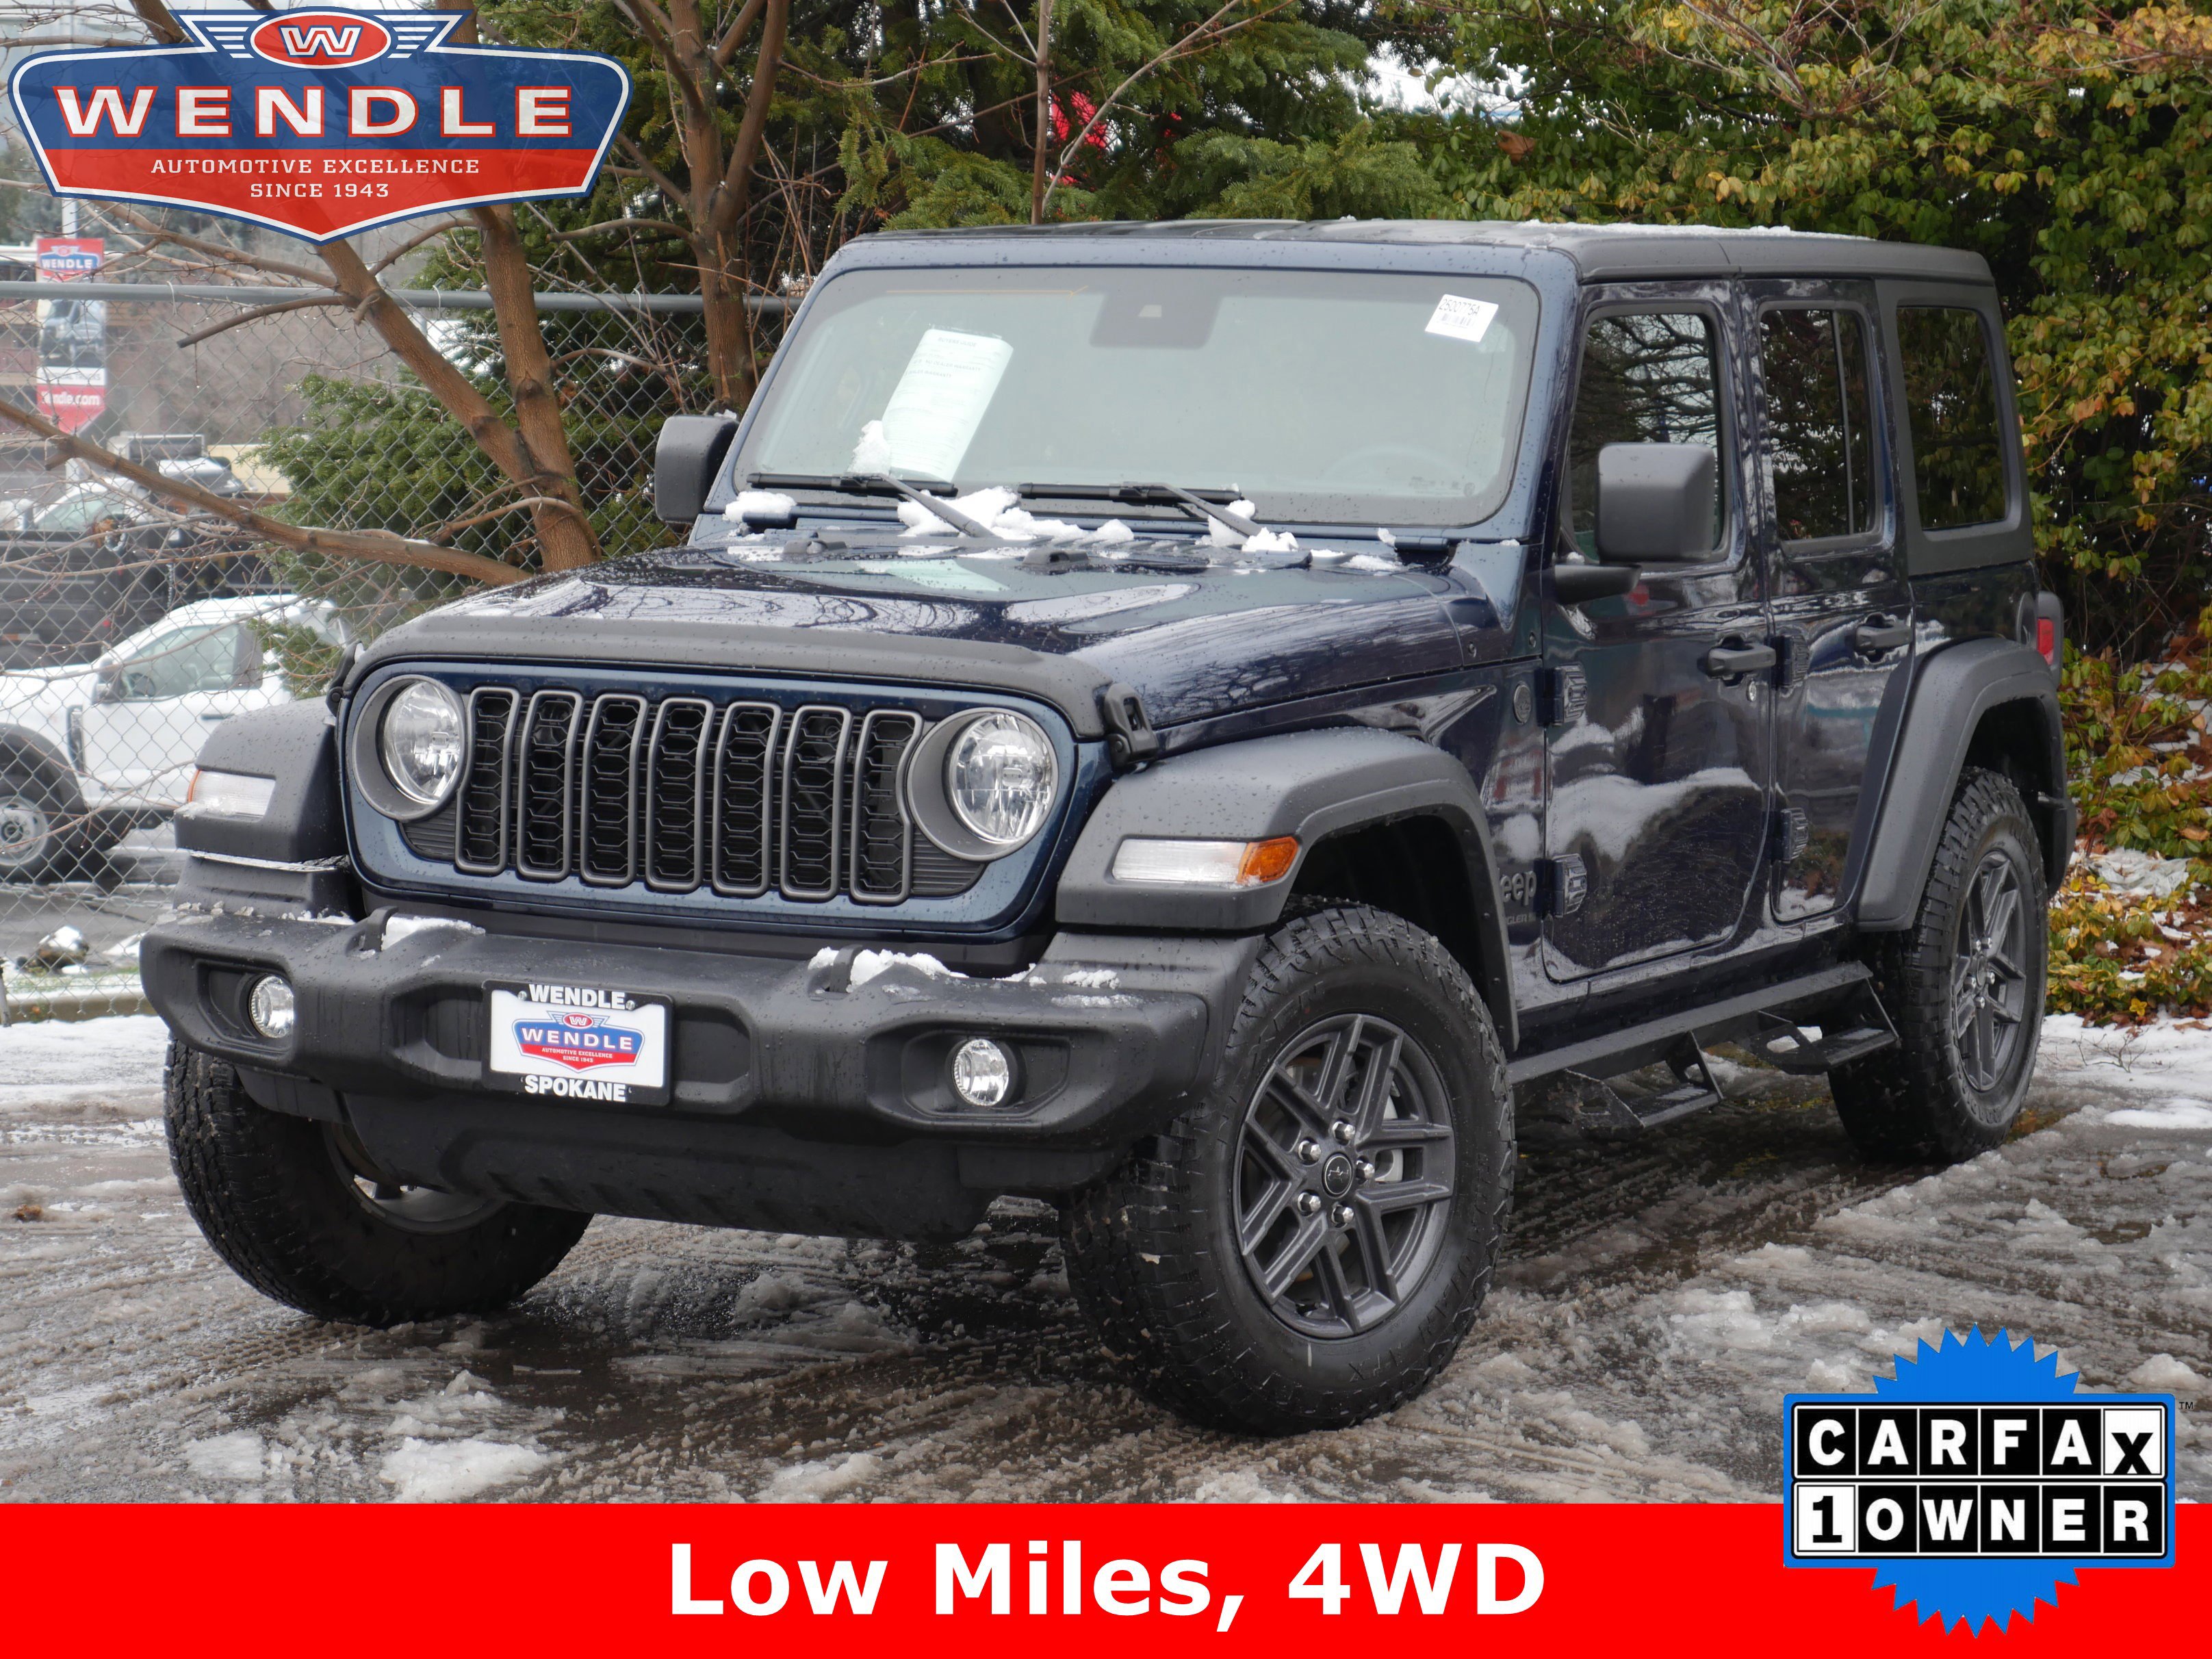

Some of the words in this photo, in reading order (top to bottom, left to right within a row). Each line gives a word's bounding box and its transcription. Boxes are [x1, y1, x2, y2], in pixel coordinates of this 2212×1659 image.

[41, 259, 93, 269] WENDLE
[1500, 871, 1536, 905] eep
[529, 984, 626, 1009] WENDLE
[569, 1016, 587, 1026] W
[522, 1027, 632, 1051] WENDLE
[542, 1047, 577, 1055] AUTOMOTIVE
[578, 1051, 613, 1059] EXCELLENCE
[525, 1075, 626, 1102] SPOKANE
